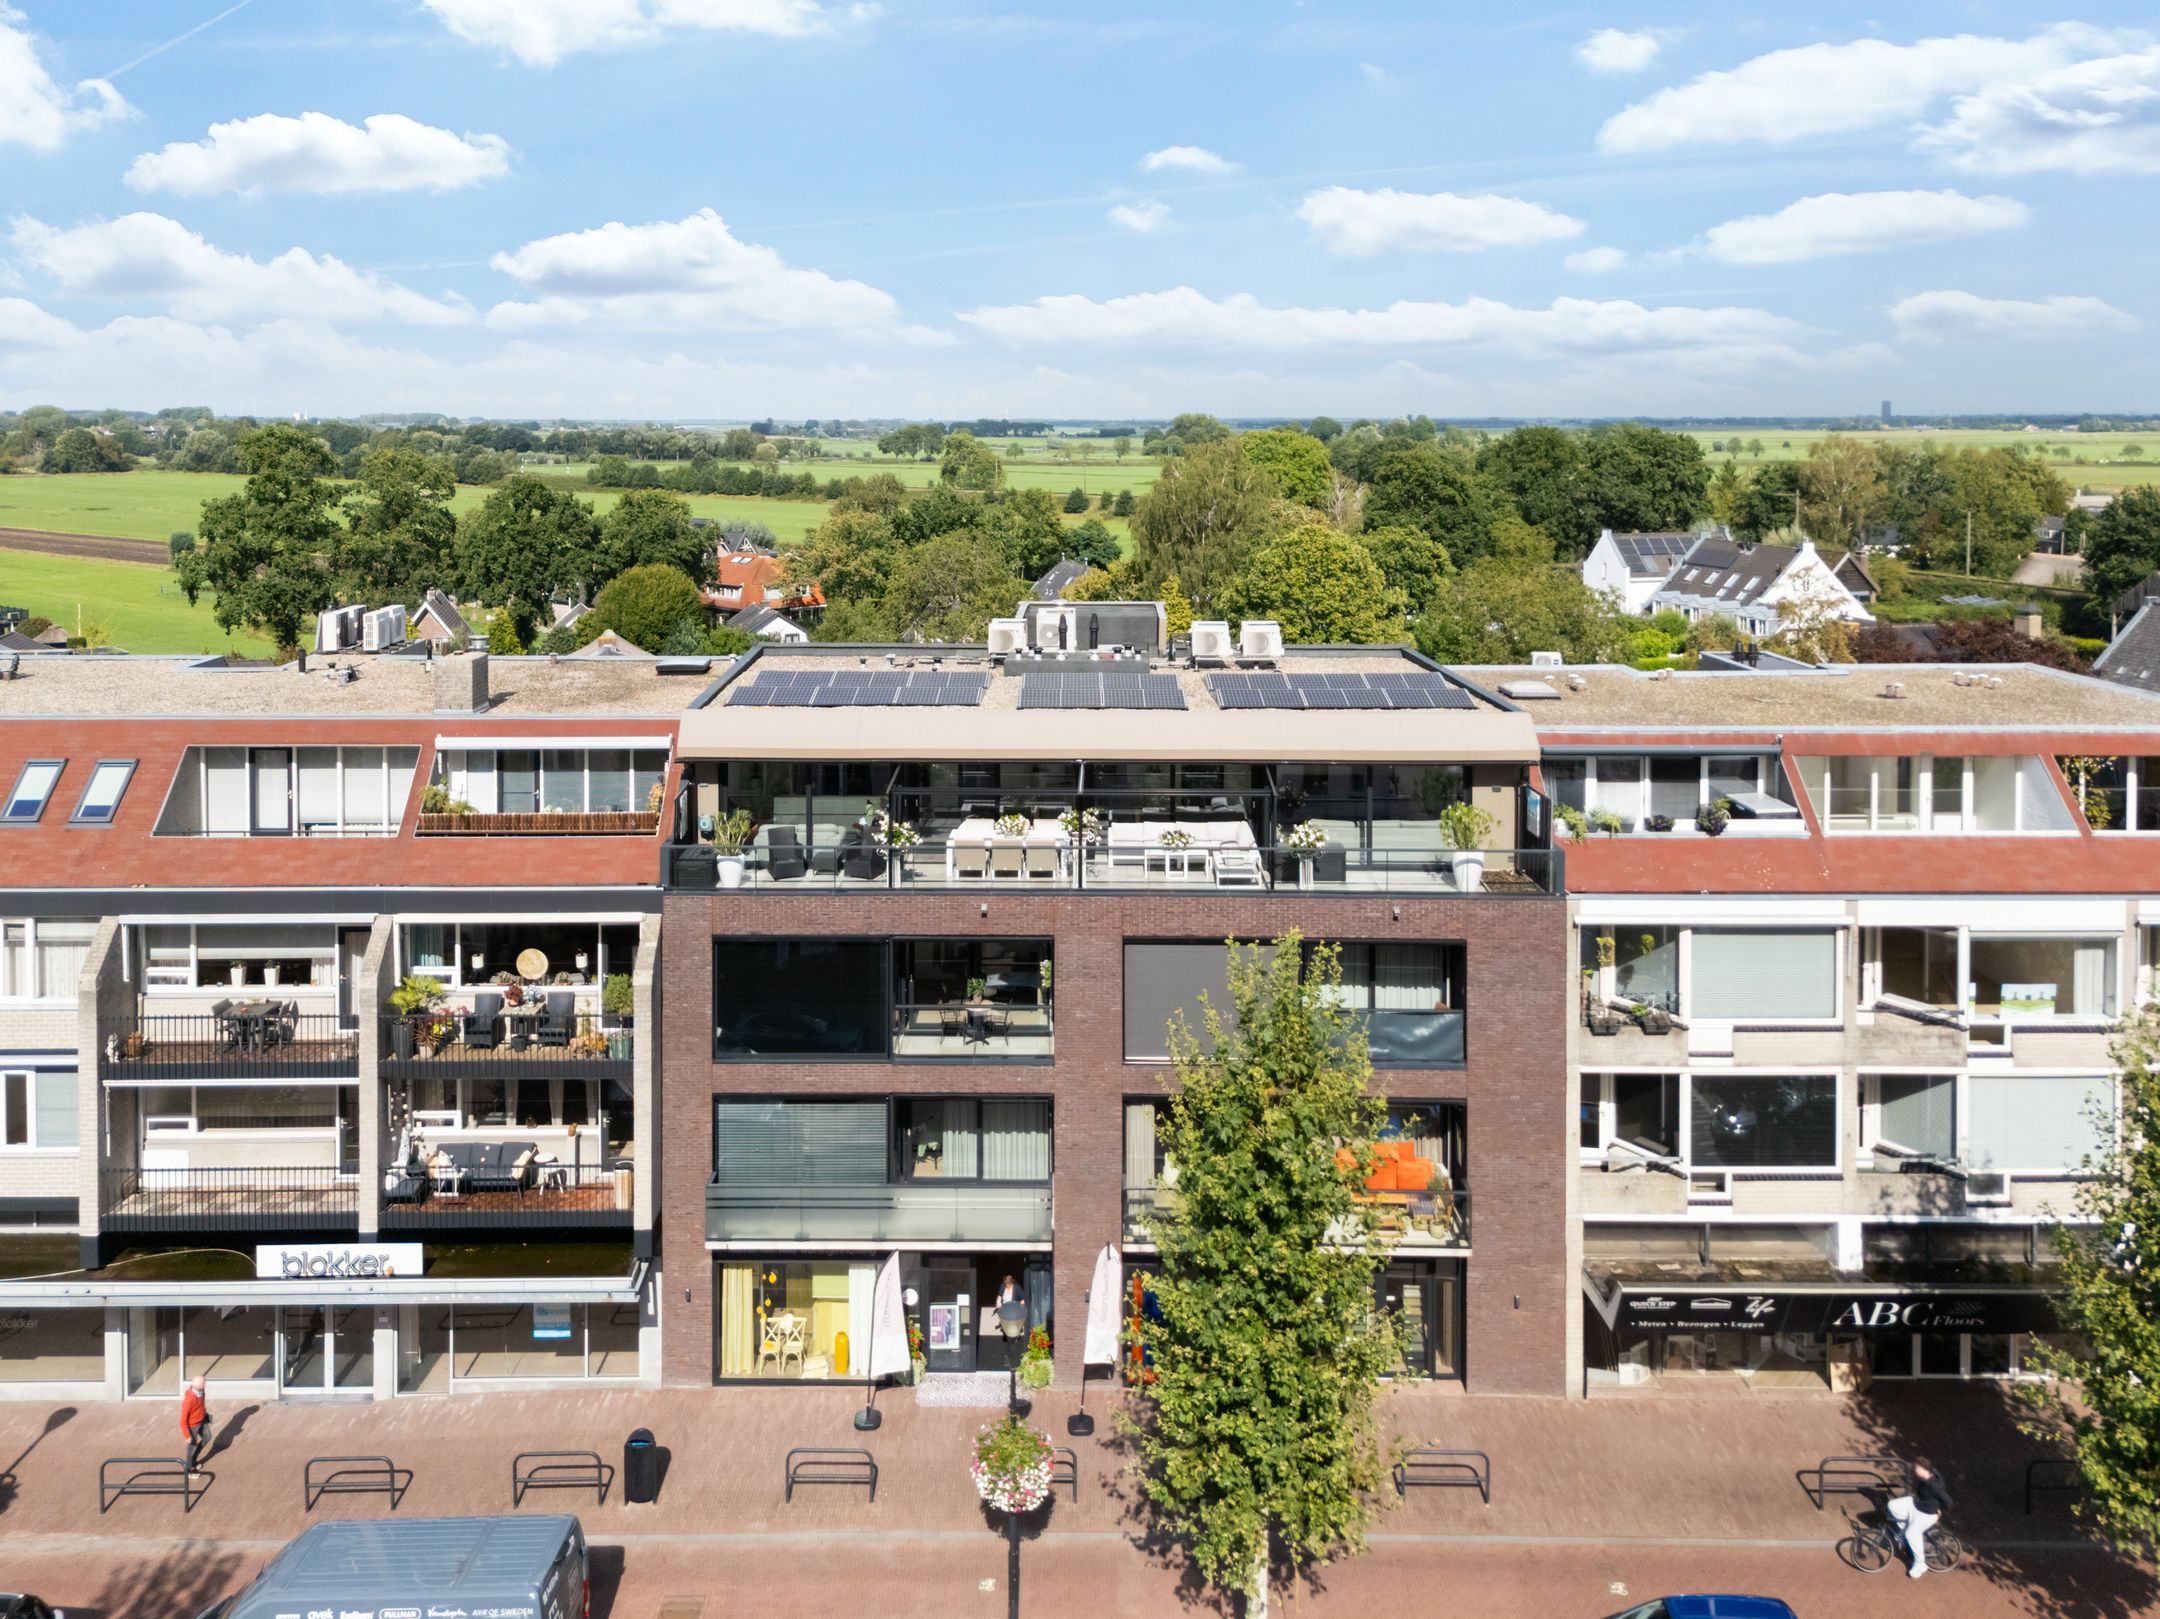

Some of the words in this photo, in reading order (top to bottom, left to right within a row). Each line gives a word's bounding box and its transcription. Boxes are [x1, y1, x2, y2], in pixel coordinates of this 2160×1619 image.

[281, 1250, 390, 1278] blokker
[1832, 1301, 1935, 1326] ABC
[1932, 1315, 1986, 1326] Floors
[1677, 1320, 1720, 1328] Bezorgen
[1731, 1320, 1765, 1328] Leggen
[500, 1607, 534, 1616] SWEDEN
